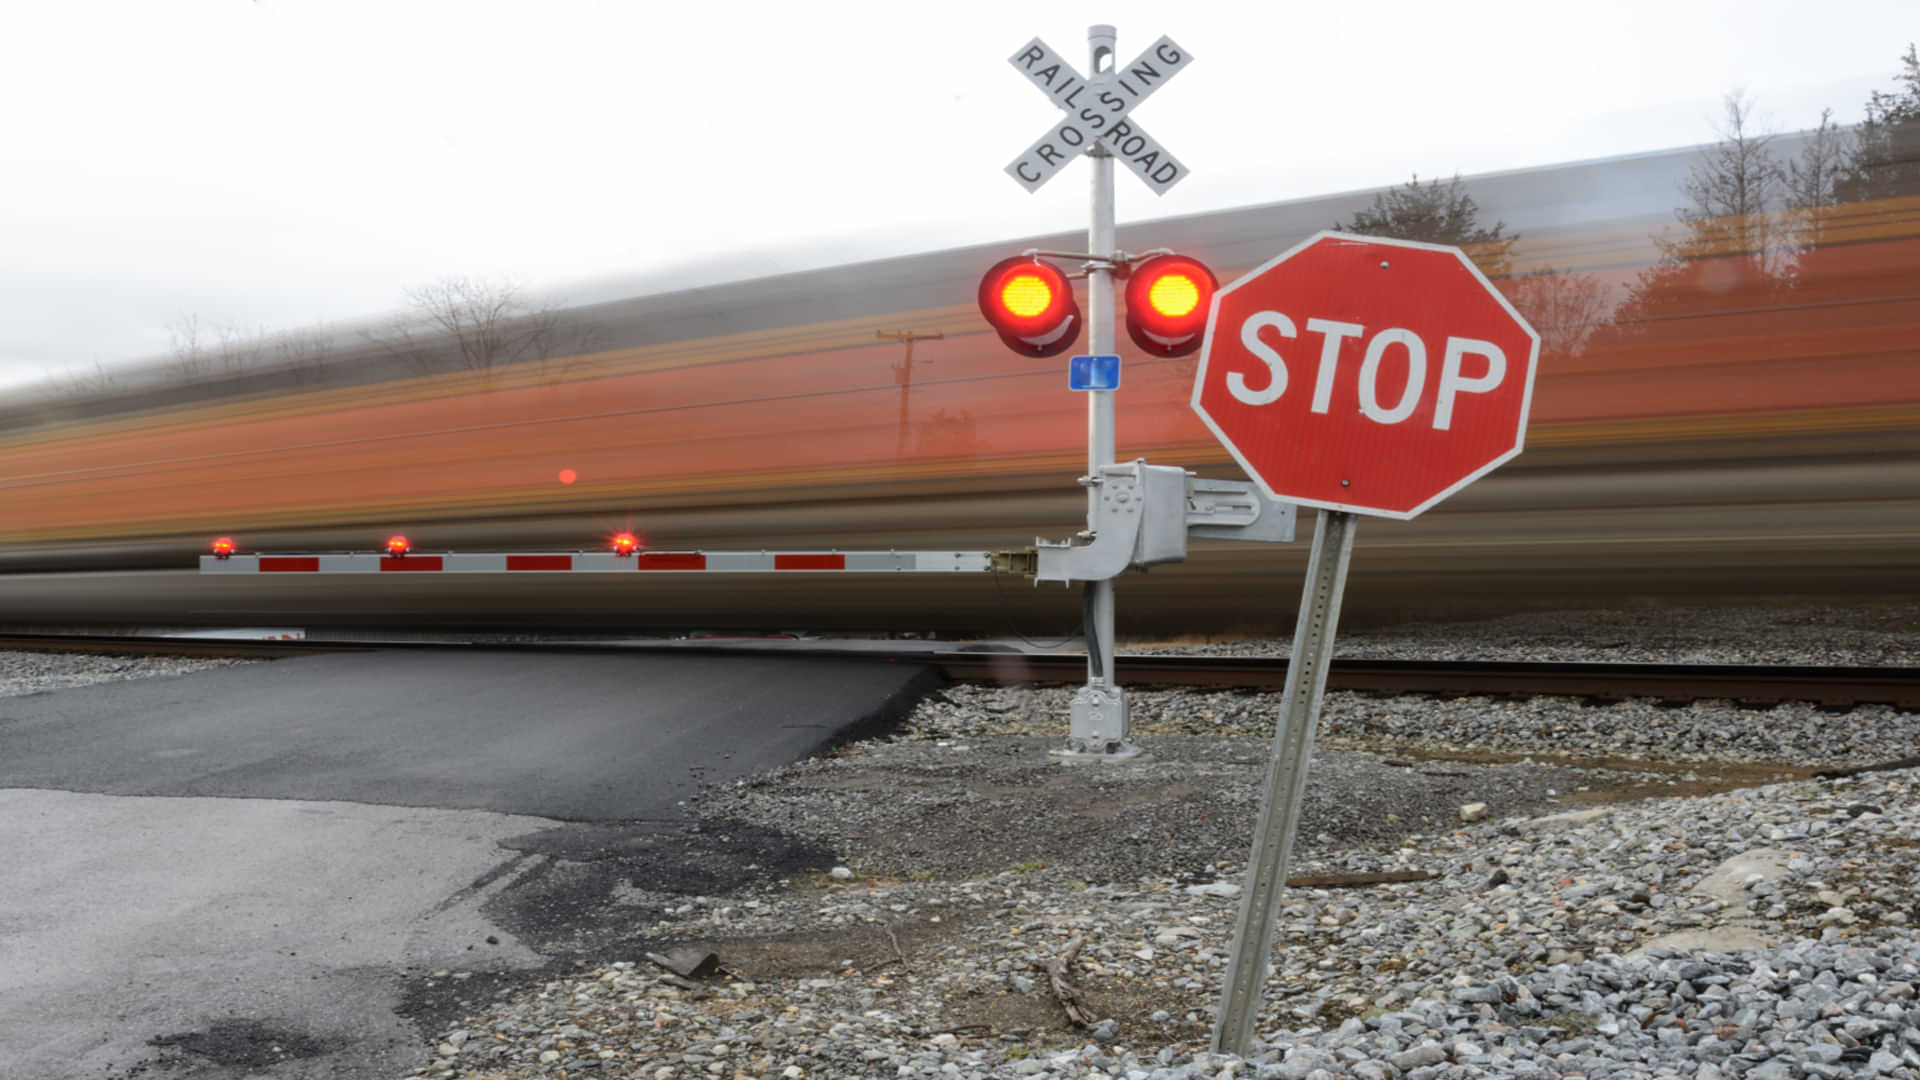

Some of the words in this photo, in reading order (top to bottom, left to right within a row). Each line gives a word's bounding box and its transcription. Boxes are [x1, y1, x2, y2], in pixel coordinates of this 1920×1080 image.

[1016, 43, 1182, 184] CROSSING
[1017, 45, 1085, 109] RAIL
[1104, 119, 1178, 185] ROAD
[1226, 310, 1507, 431] STOP
